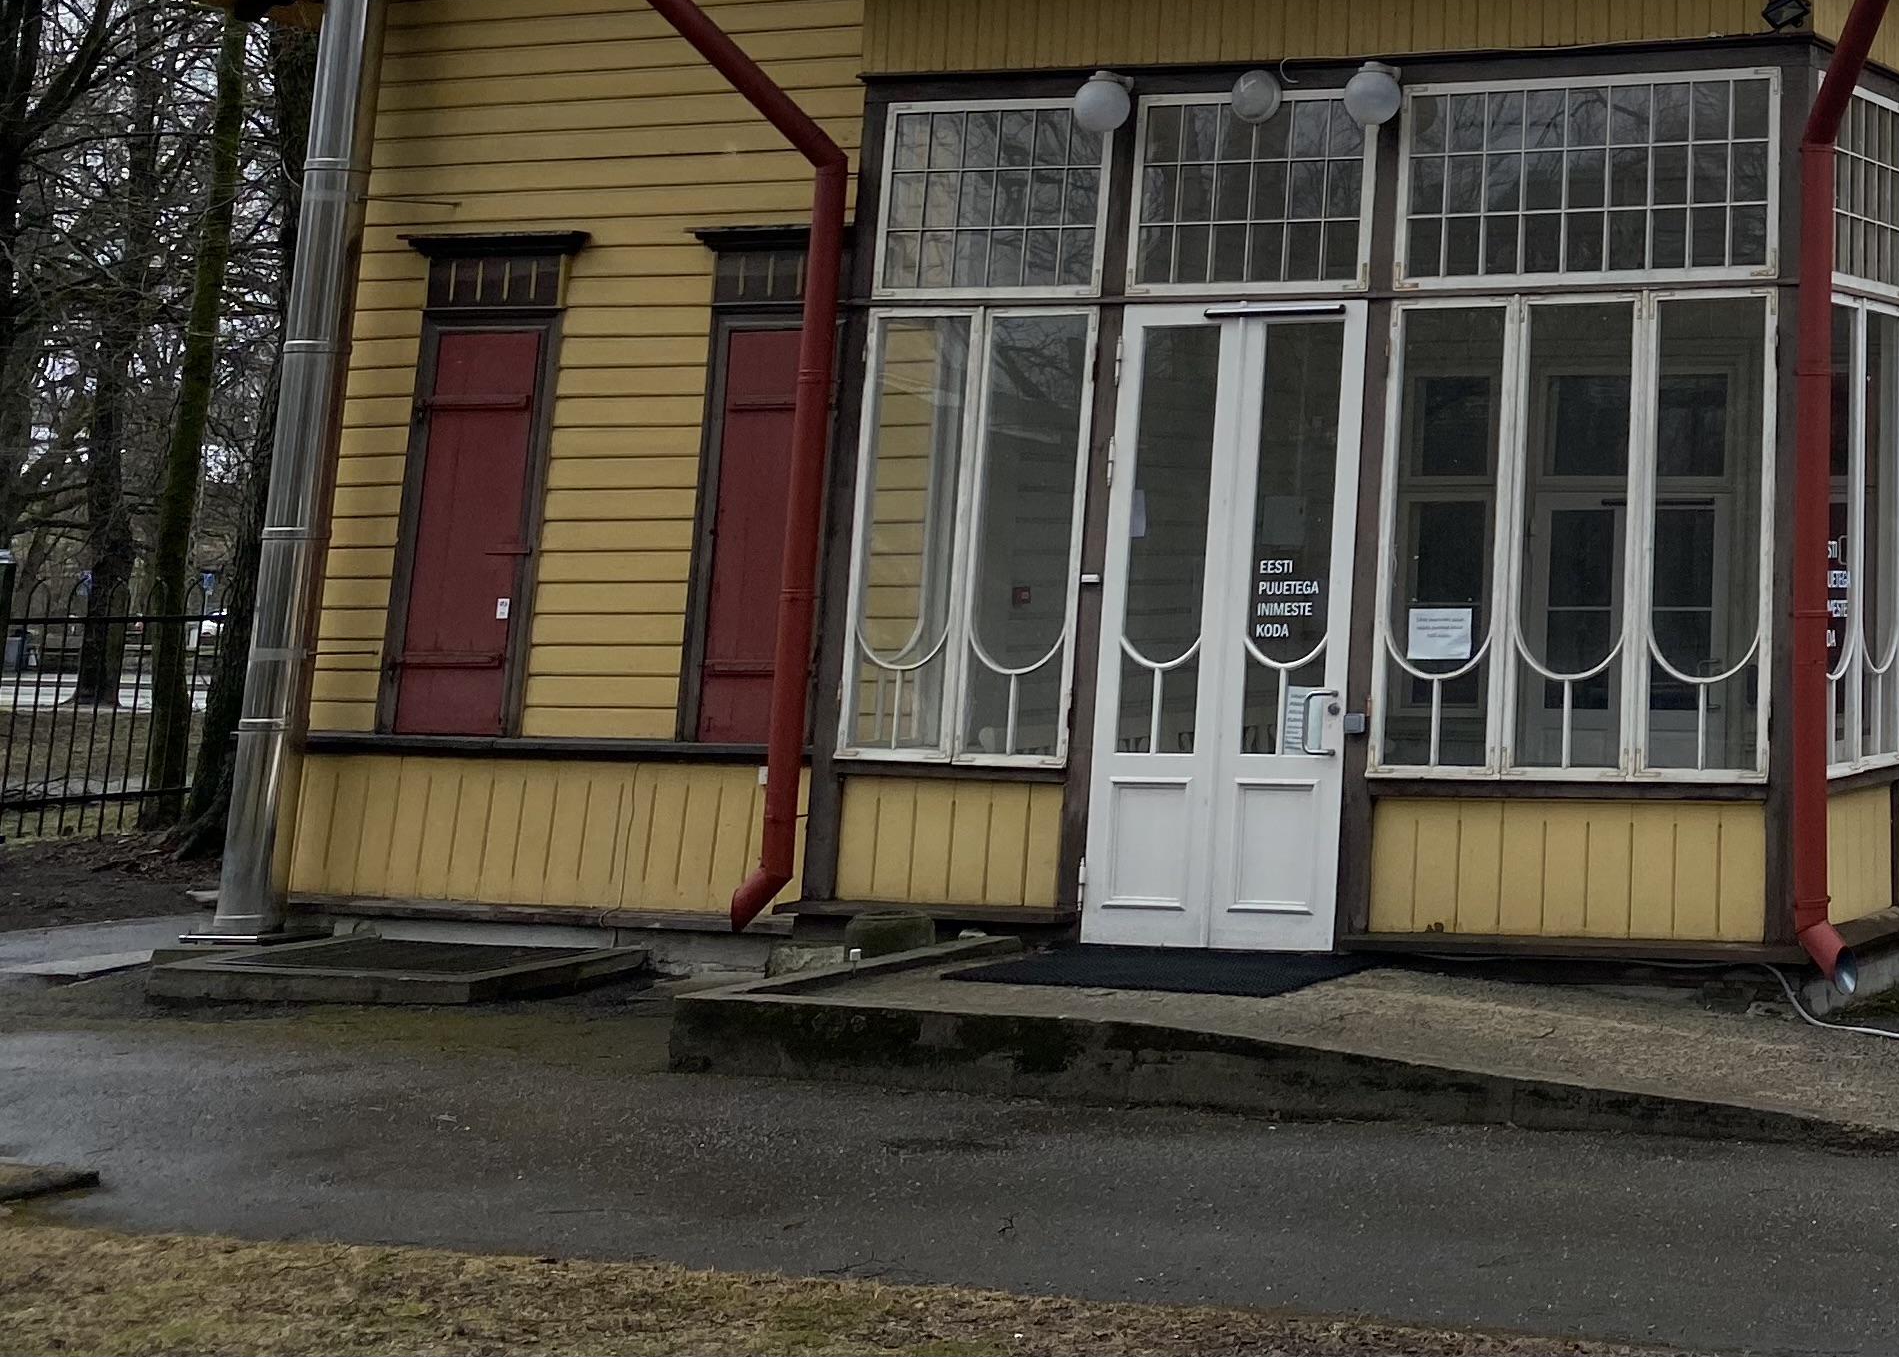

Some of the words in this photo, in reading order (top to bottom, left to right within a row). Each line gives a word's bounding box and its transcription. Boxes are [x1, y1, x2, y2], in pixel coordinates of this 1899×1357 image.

[1260, 560, 1293, 573] EESTI
[1259, 581, 1319, 594] PUUETEGA
[1258, 602, 1312, 615] INIMESTE
[1256, 624, 1289, 637] KODA
